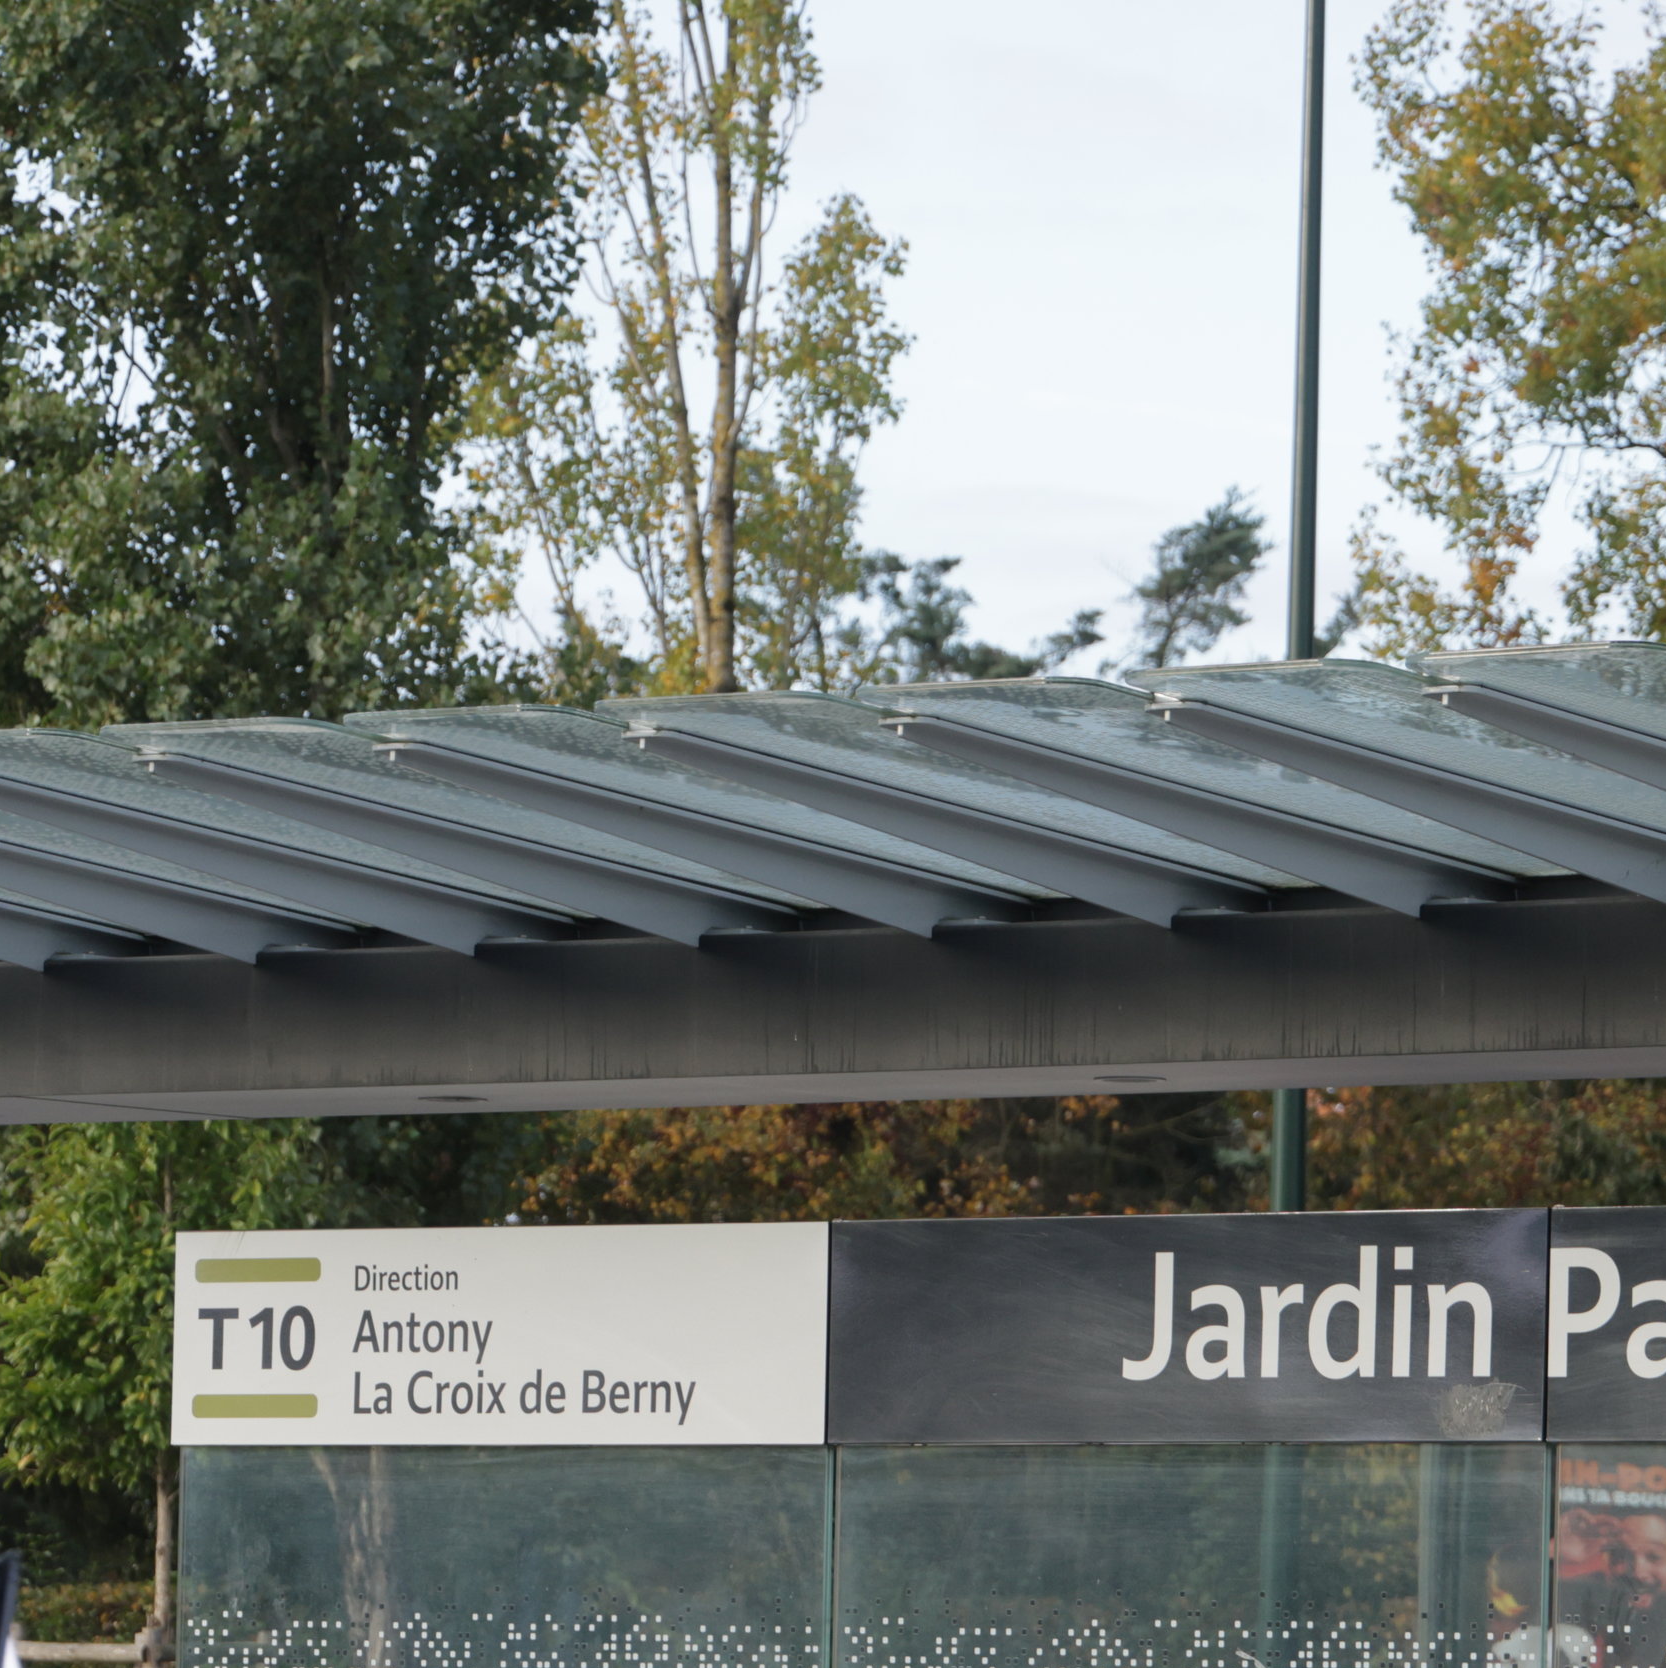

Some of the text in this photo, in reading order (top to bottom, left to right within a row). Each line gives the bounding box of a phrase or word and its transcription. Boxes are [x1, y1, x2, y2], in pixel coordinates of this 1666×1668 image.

[353, 1264, 460, 1292] Direction
[197, 1304, 318, 1372] T10
[351, 1309, 494, 1364] Antony
[1121, 1244, 1495, 1381] Jardin
[352, 1368, 697, 1425] La Croix de Berny
